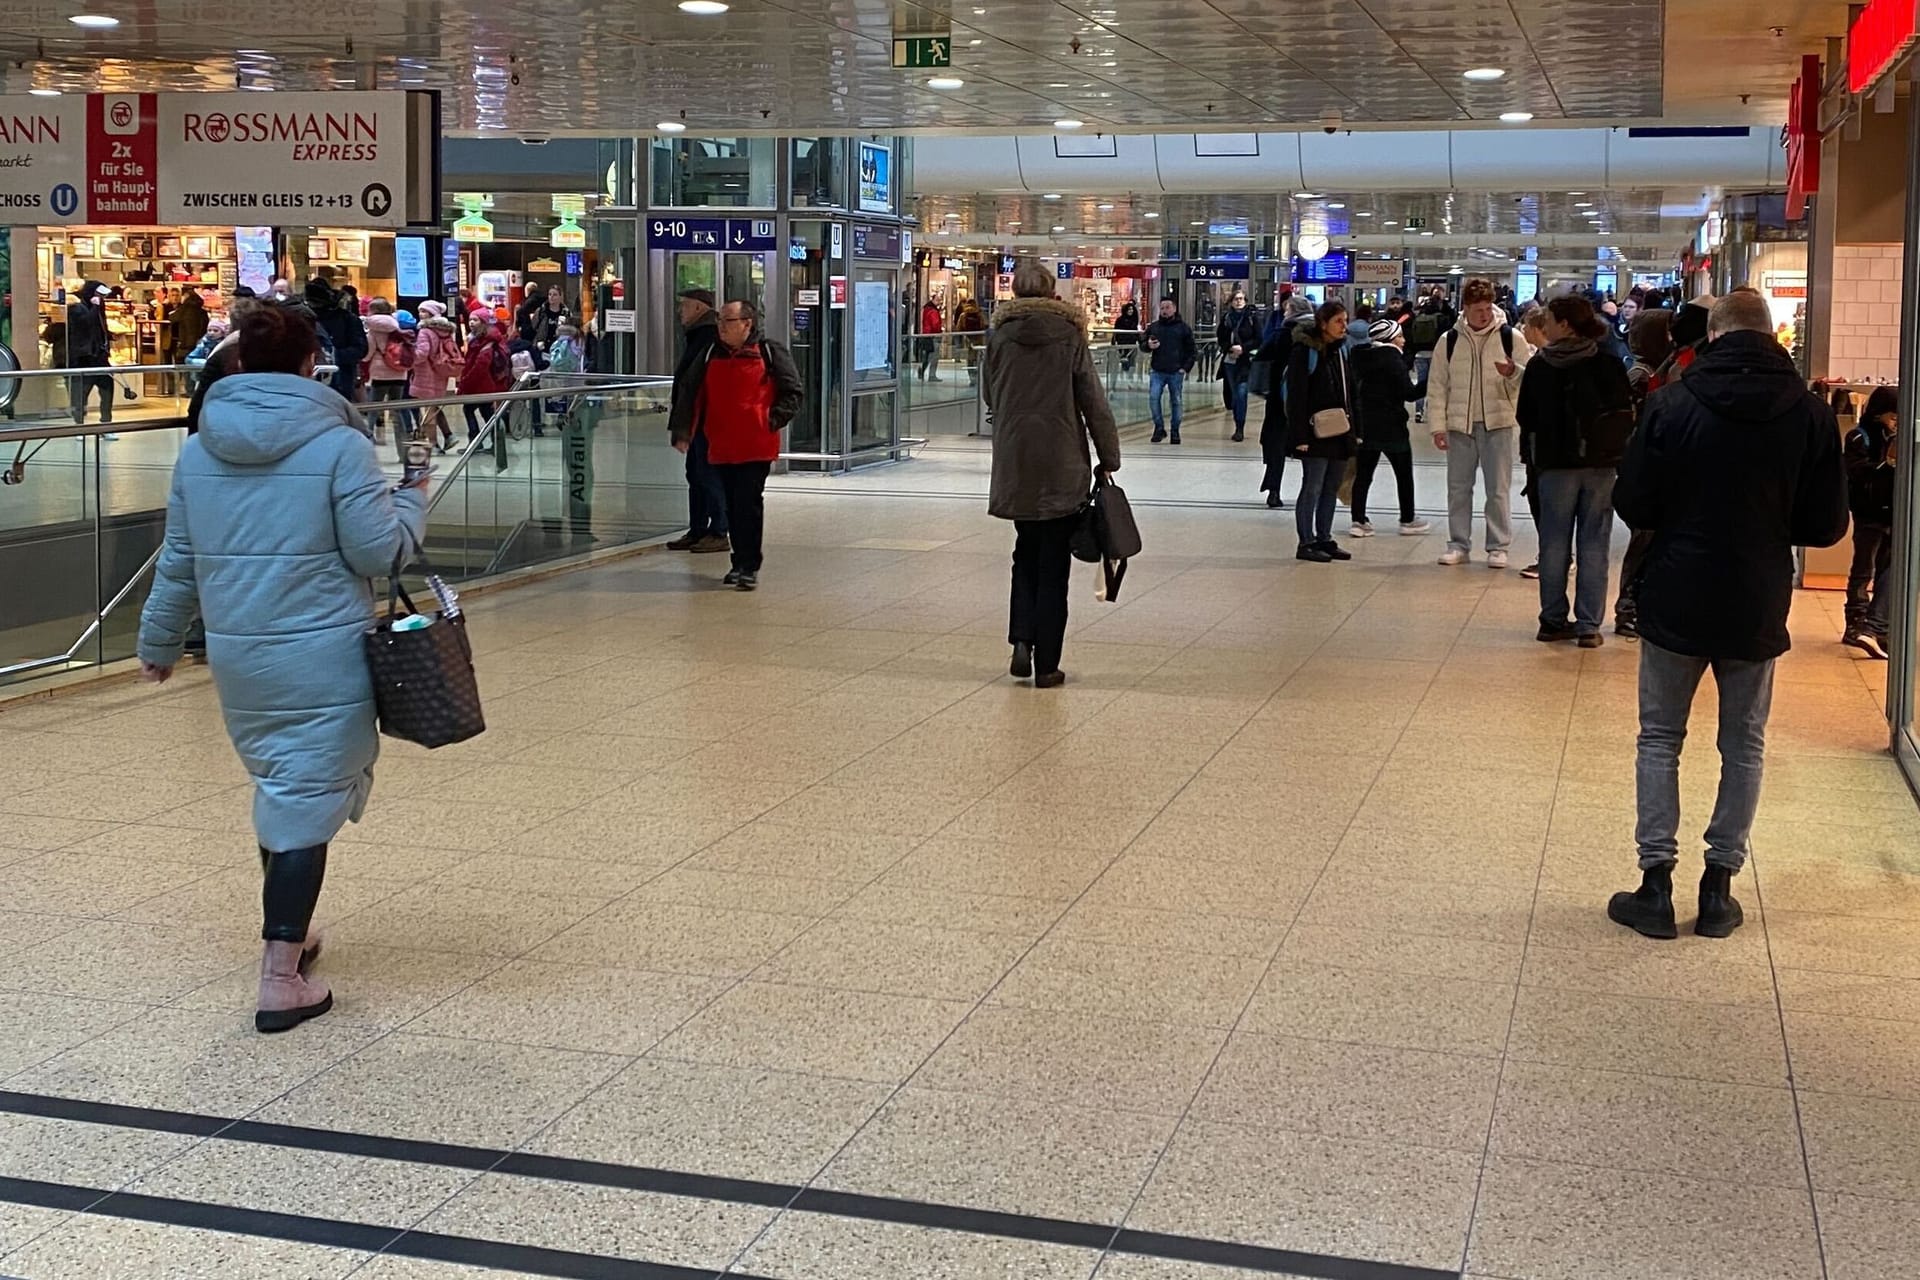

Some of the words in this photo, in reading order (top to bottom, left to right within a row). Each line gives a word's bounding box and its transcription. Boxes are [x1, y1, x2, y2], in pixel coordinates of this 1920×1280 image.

[184, 112, 377, 143] ROSSMANN
[111, 141, 132, 158] 2x
[293, 143, 378, 161] EXPRESS
[100, 162, 119, 176] für
[123, 162, 144, 176] Sie
[93, 180, 109, 193] im
[112, 180, 155, 197] Haupt-
[96, 198, 149, 212] bahnhof
[183, 193, 257, 207] ZWISCHEN
[262, 192, 304, 207] GLEIS
[653, 221, 686, 237] 9-10
[759, 222, 769, 235] U
[1058, 263, 1066, 274] 3
[1092, 266, 1114, 280] RELAY
[1189, 265, 1207, 276] 7-8
[570, 436, 585, 502] Abfall
